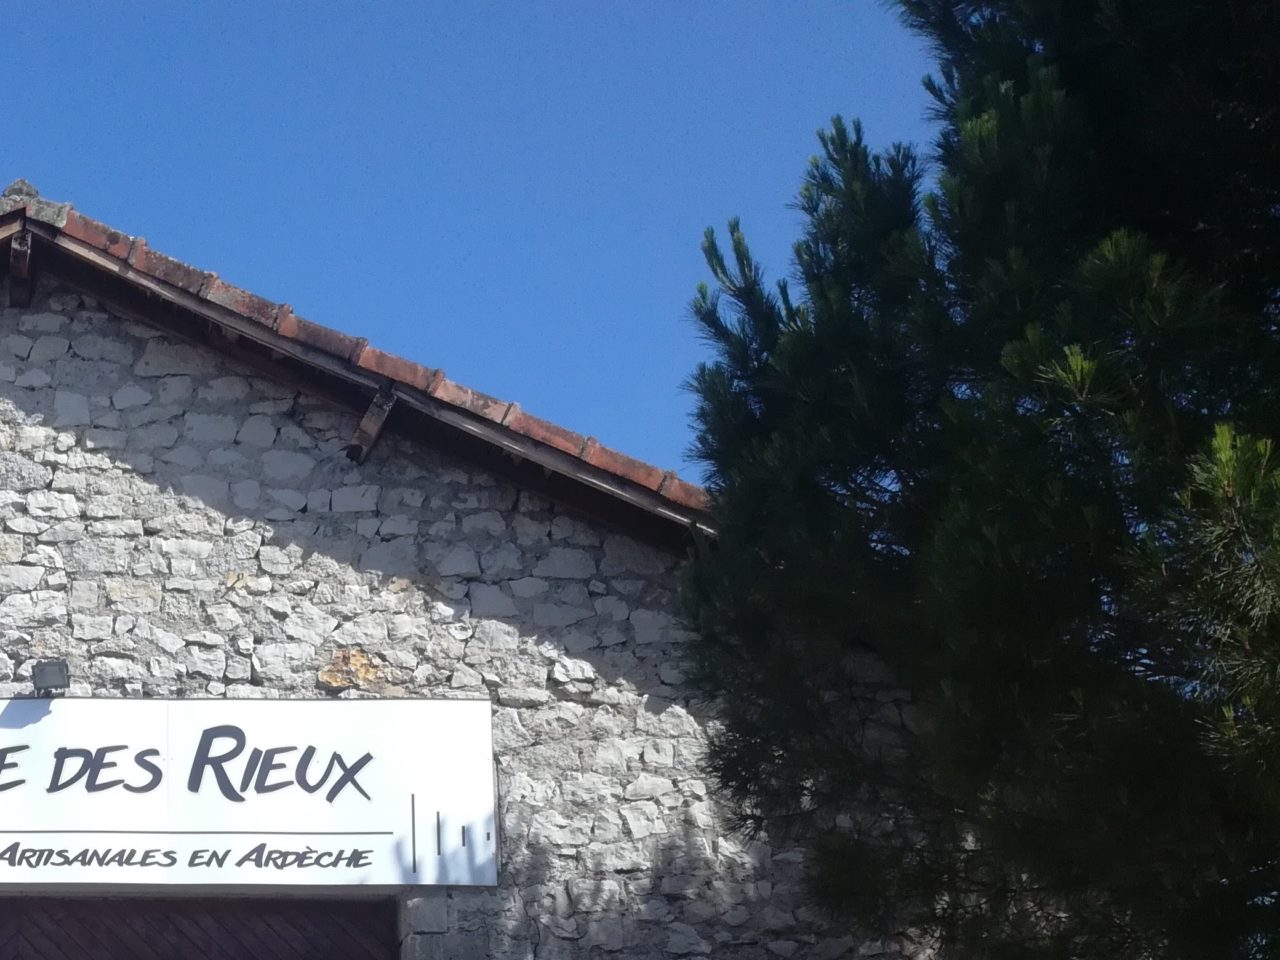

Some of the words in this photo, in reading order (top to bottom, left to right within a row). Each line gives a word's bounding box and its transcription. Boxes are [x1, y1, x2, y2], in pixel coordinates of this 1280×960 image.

[46, 745, 163, 794] DES
[187, 724, 374, 804] RIEUX
[187, 849, 232, 868] EN
[235, 843, 374, 870] ARDÈCHE
